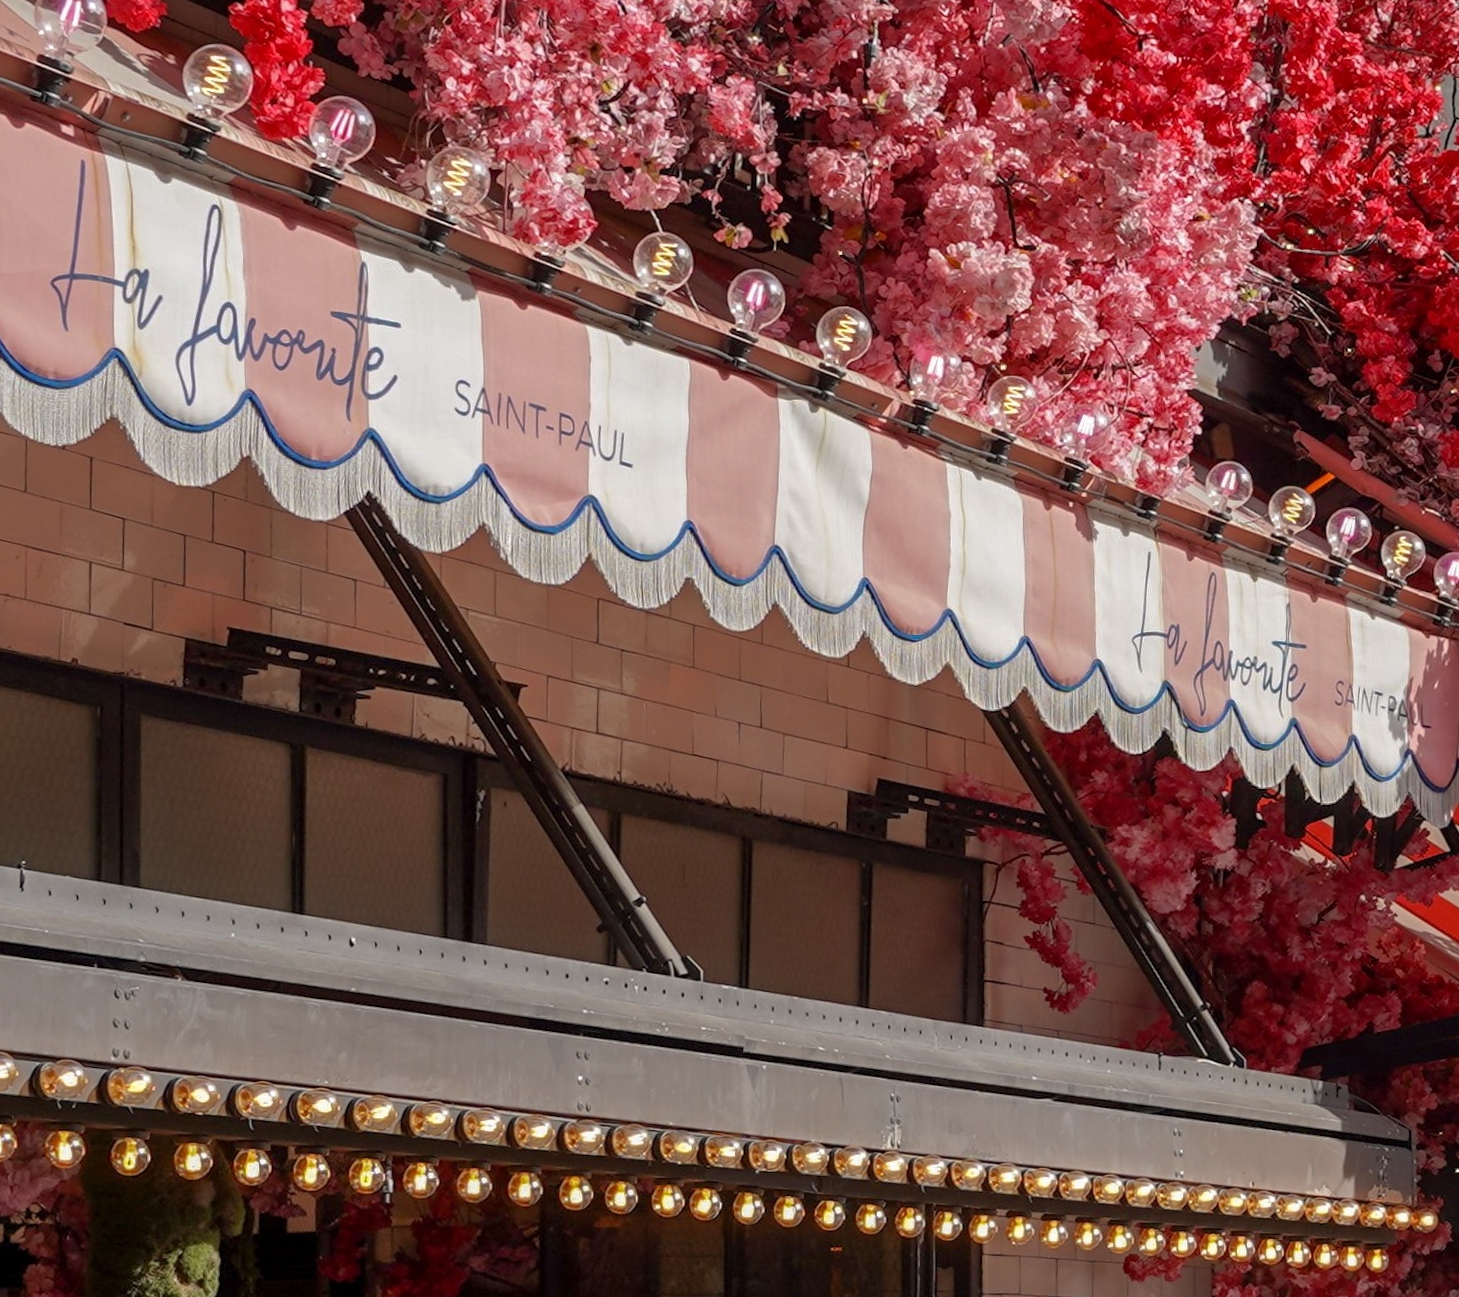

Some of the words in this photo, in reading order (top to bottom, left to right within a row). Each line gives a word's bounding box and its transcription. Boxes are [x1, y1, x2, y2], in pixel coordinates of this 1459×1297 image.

[50, 159, 164, 332] La
[175, 204, 402, 423] favorite
[454, 379, 633, 469] SAINT-PAUL
[1131, 551, 1187, 673] La
[1193, 571, 1307, 718] favorite
[1334, 680, 1432, 729] SAINT-PAUL
